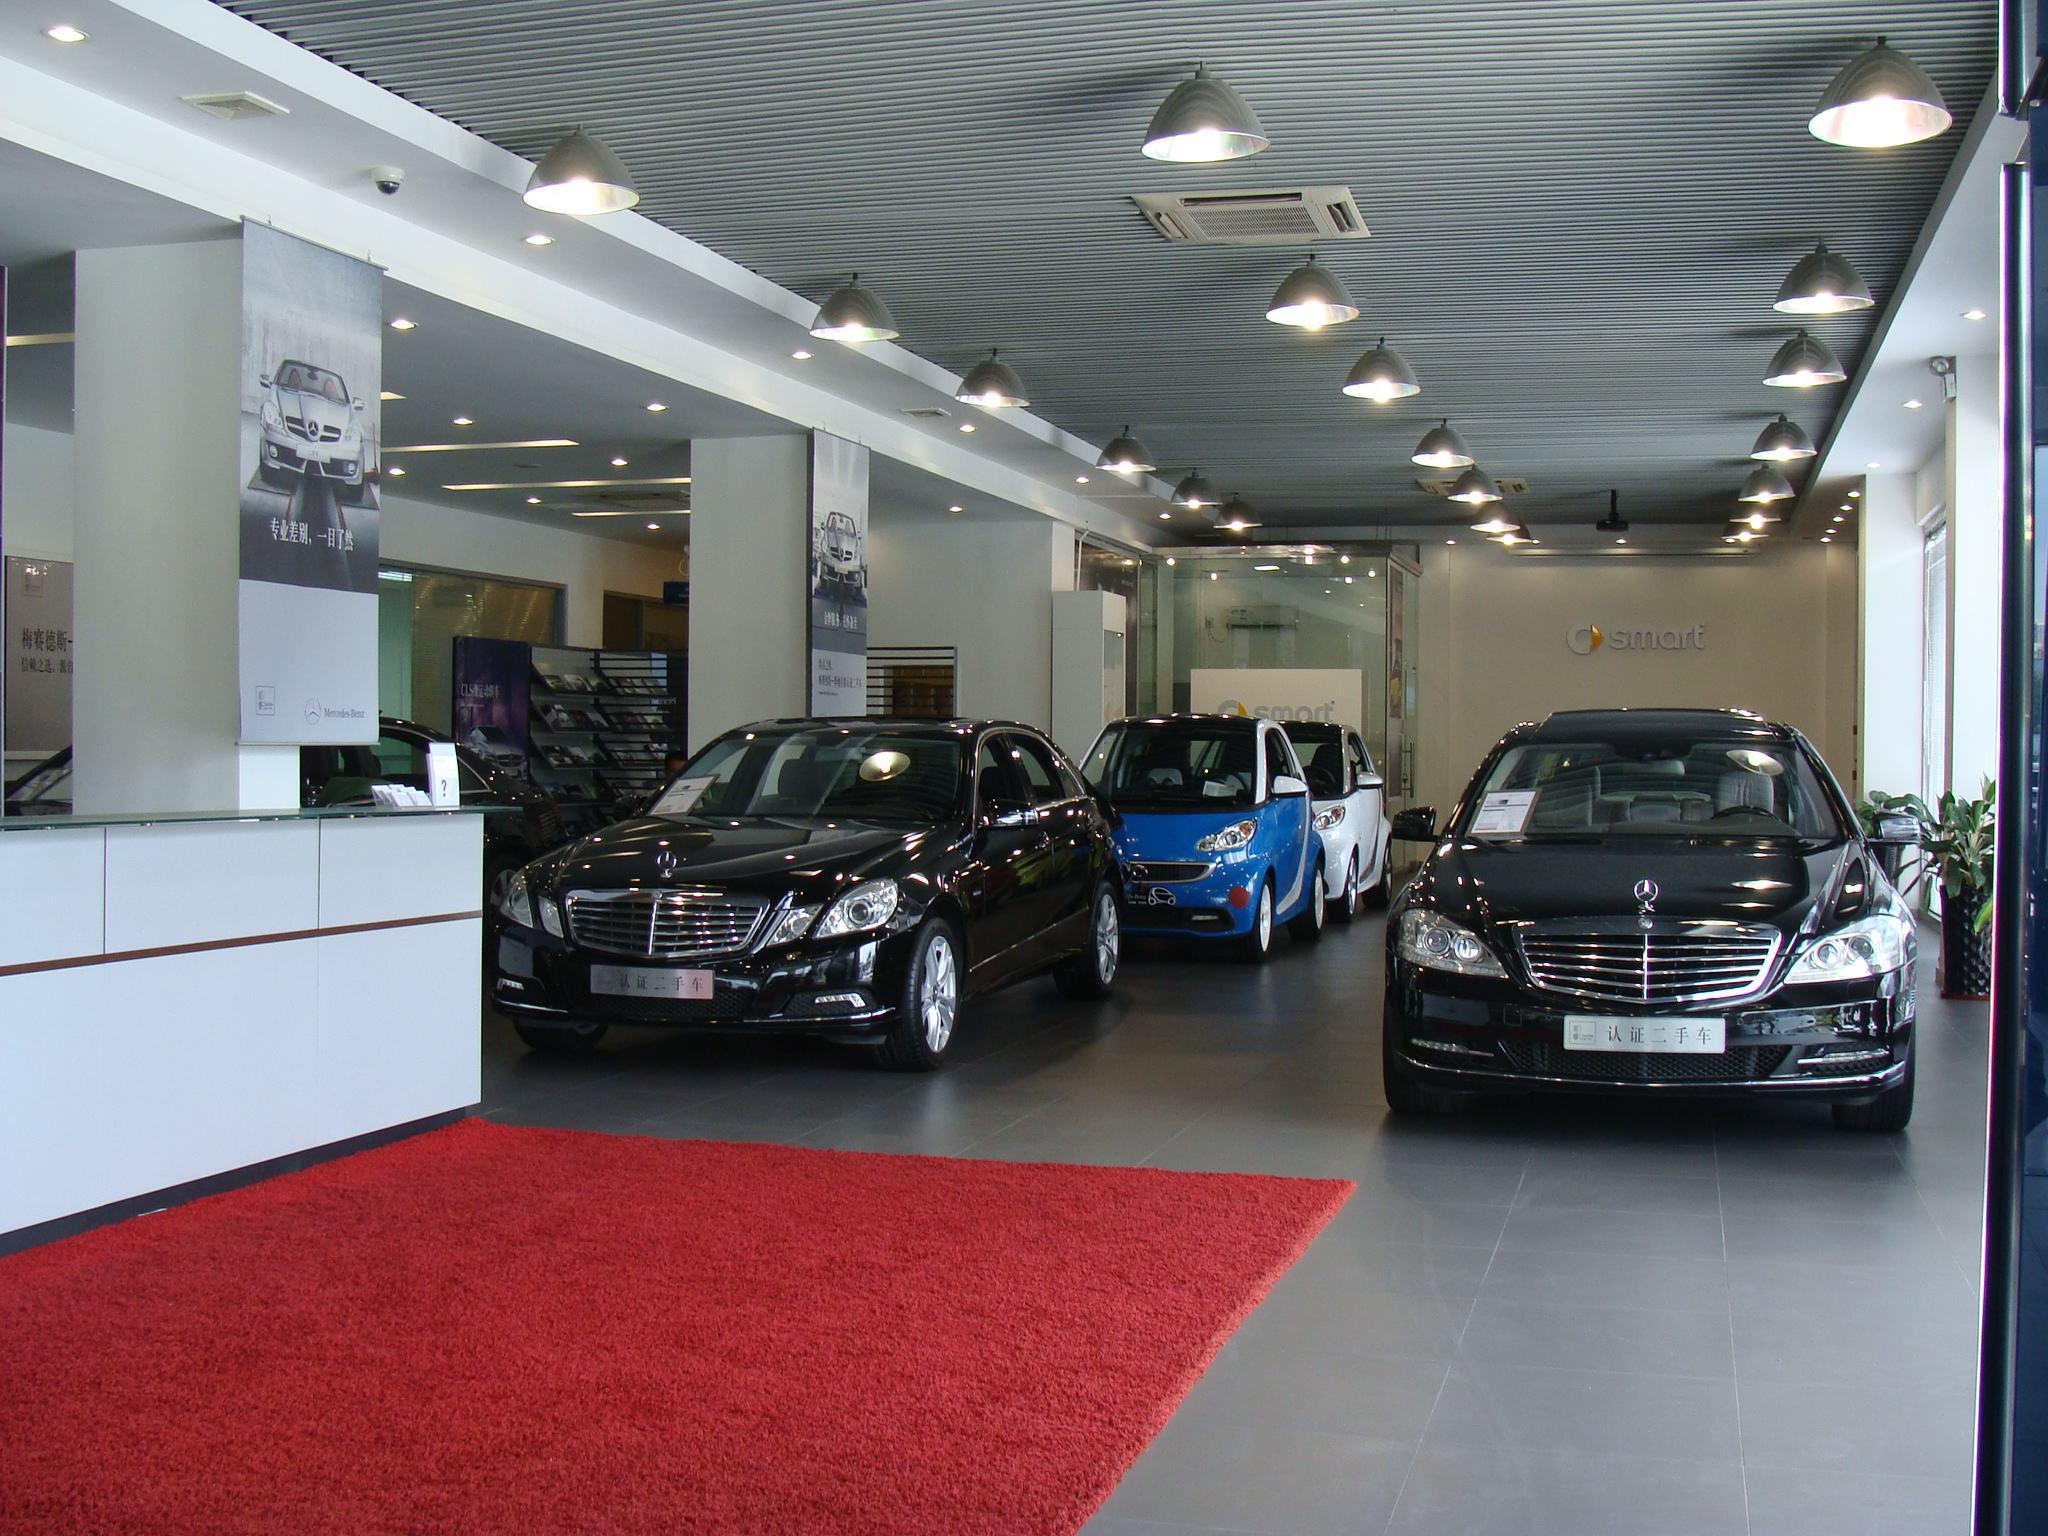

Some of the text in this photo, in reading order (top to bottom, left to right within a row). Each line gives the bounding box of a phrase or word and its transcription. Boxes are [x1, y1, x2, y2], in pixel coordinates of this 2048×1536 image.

[1608, 625, 1706, 651] smart
[1254, 702, 1333, 721] smart
[621, 974, 704, 993] 认证二手车
[1607, 1025, 1712, 1045] 认证二手车
